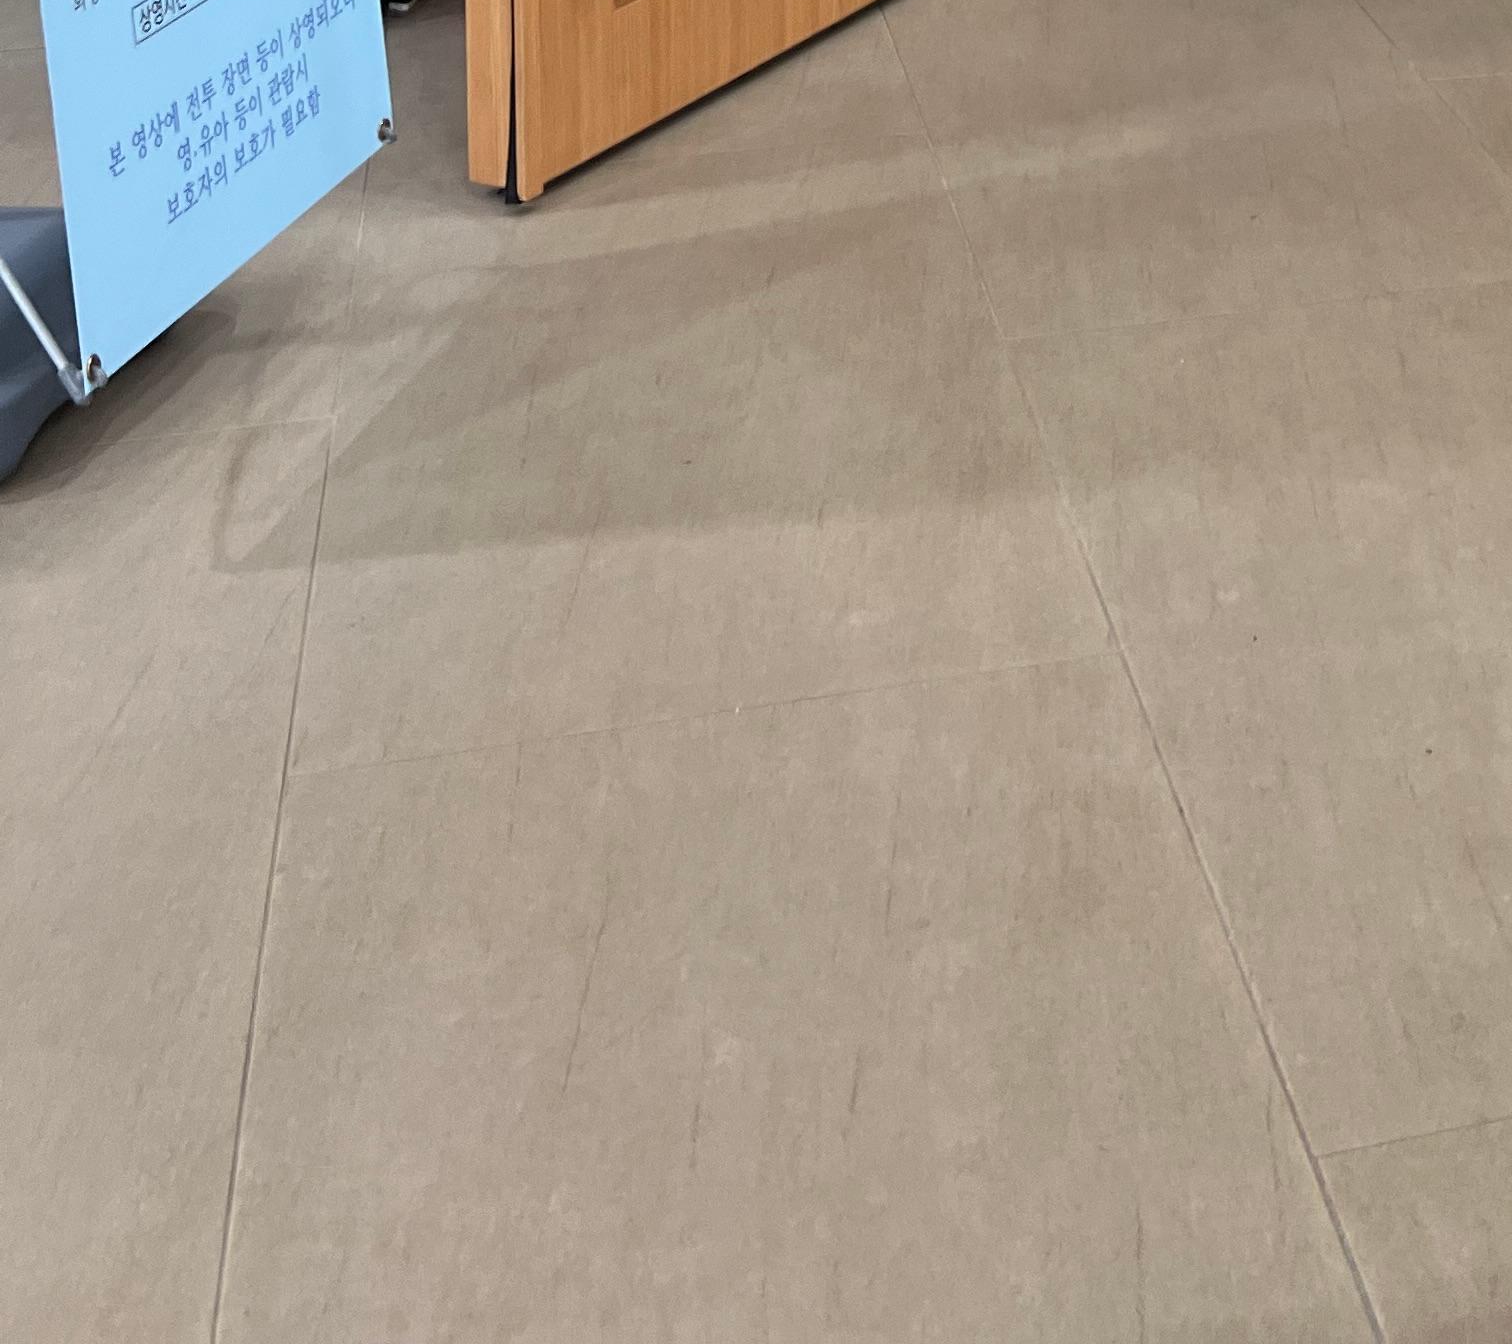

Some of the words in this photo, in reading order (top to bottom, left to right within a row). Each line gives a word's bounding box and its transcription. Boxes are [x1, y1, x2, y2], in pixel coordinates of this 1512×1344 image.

[109, 141, 126, 177] 본
[132, 101, 180, 159] 영상에
[186, 78, 217, 121] 전투
[221, 51, 252, 96] 장면
[256, 28, 284, 72] 등이
[168, 154, 228, 225] 보호자의
[234, 118, 276, 173] 보호가
[281, 84, 321, 137] 필요함
[234, 85, 263, 131] 등이
[268, 52, 308, 106] 관람시
